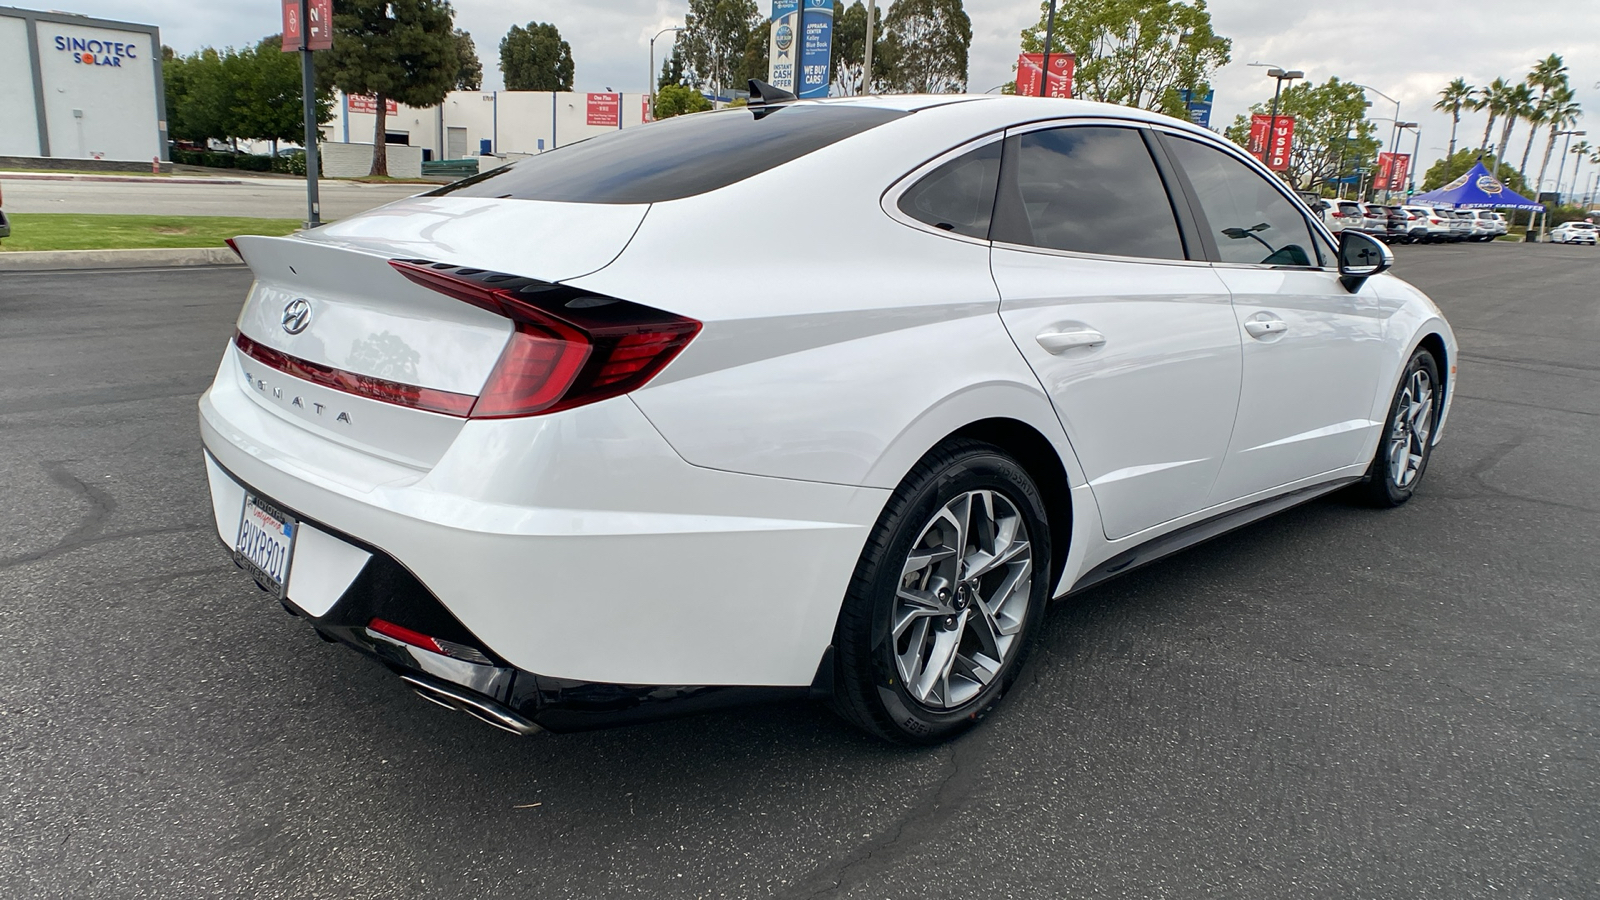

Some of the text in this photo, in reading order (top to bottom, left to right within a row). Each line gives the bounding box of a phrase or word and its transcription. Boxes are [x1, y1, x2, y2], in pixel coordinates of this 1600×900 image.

[310, 7, 319, 37] 12
[54, 35, 137, 59] SINOTEC
[73, 52, 121, 67] SOLAR
[804, 65, 827, 75] WE BUY
[806, 75, 823, 84] CARS!
[1058, 69, 1068, 91] Mile
[1273, 127, 1288, 166] USED
[256, 497, 283, 519] TOYOTA
[240, 518, 285, 582] 8VXR901
